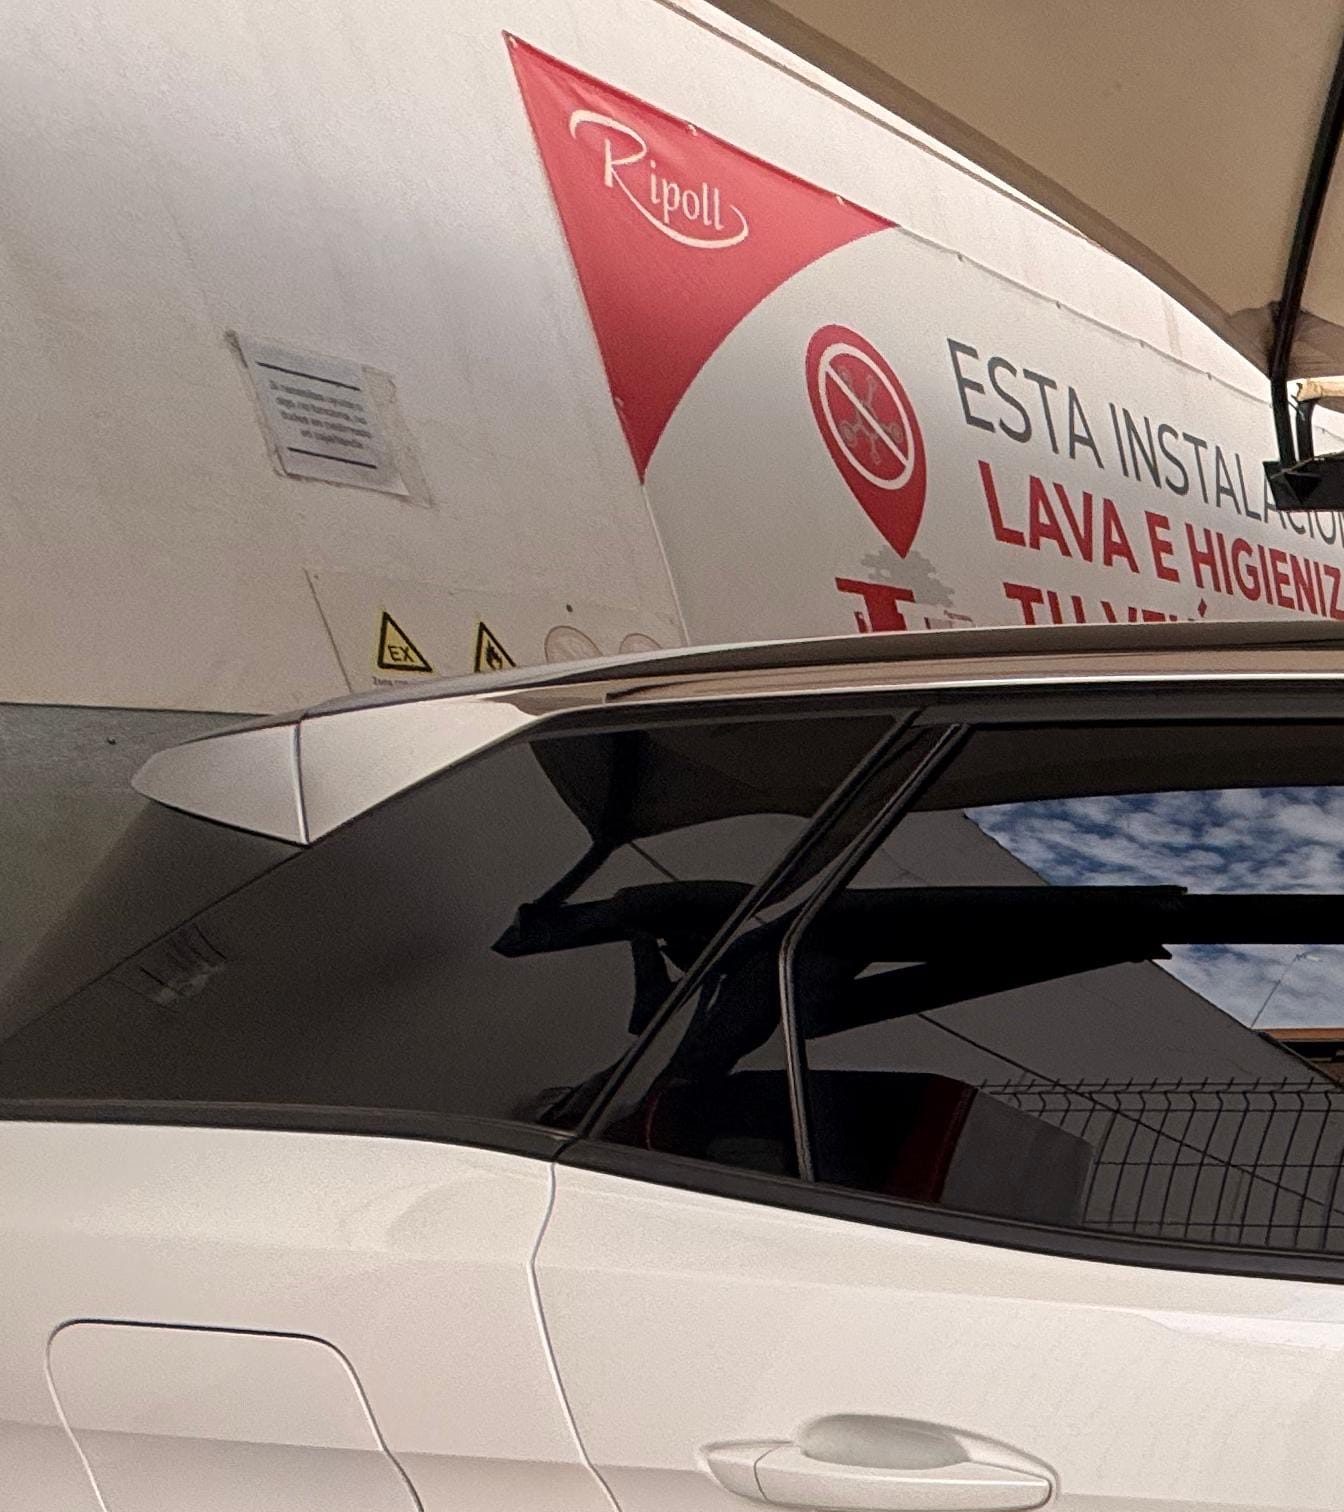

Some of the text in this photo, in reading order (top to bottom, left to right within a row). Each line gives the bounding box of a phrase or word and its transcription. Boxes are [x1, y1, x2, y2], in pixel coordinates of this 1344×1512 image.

[569, 109, 749, 249] Ripoll
[947, 338, 1104, 470] ESTA
[978, 460, 1140, 574] LAVA
[1144, 510, 1181, 584] E
[388, 646, 415, 662] EX
